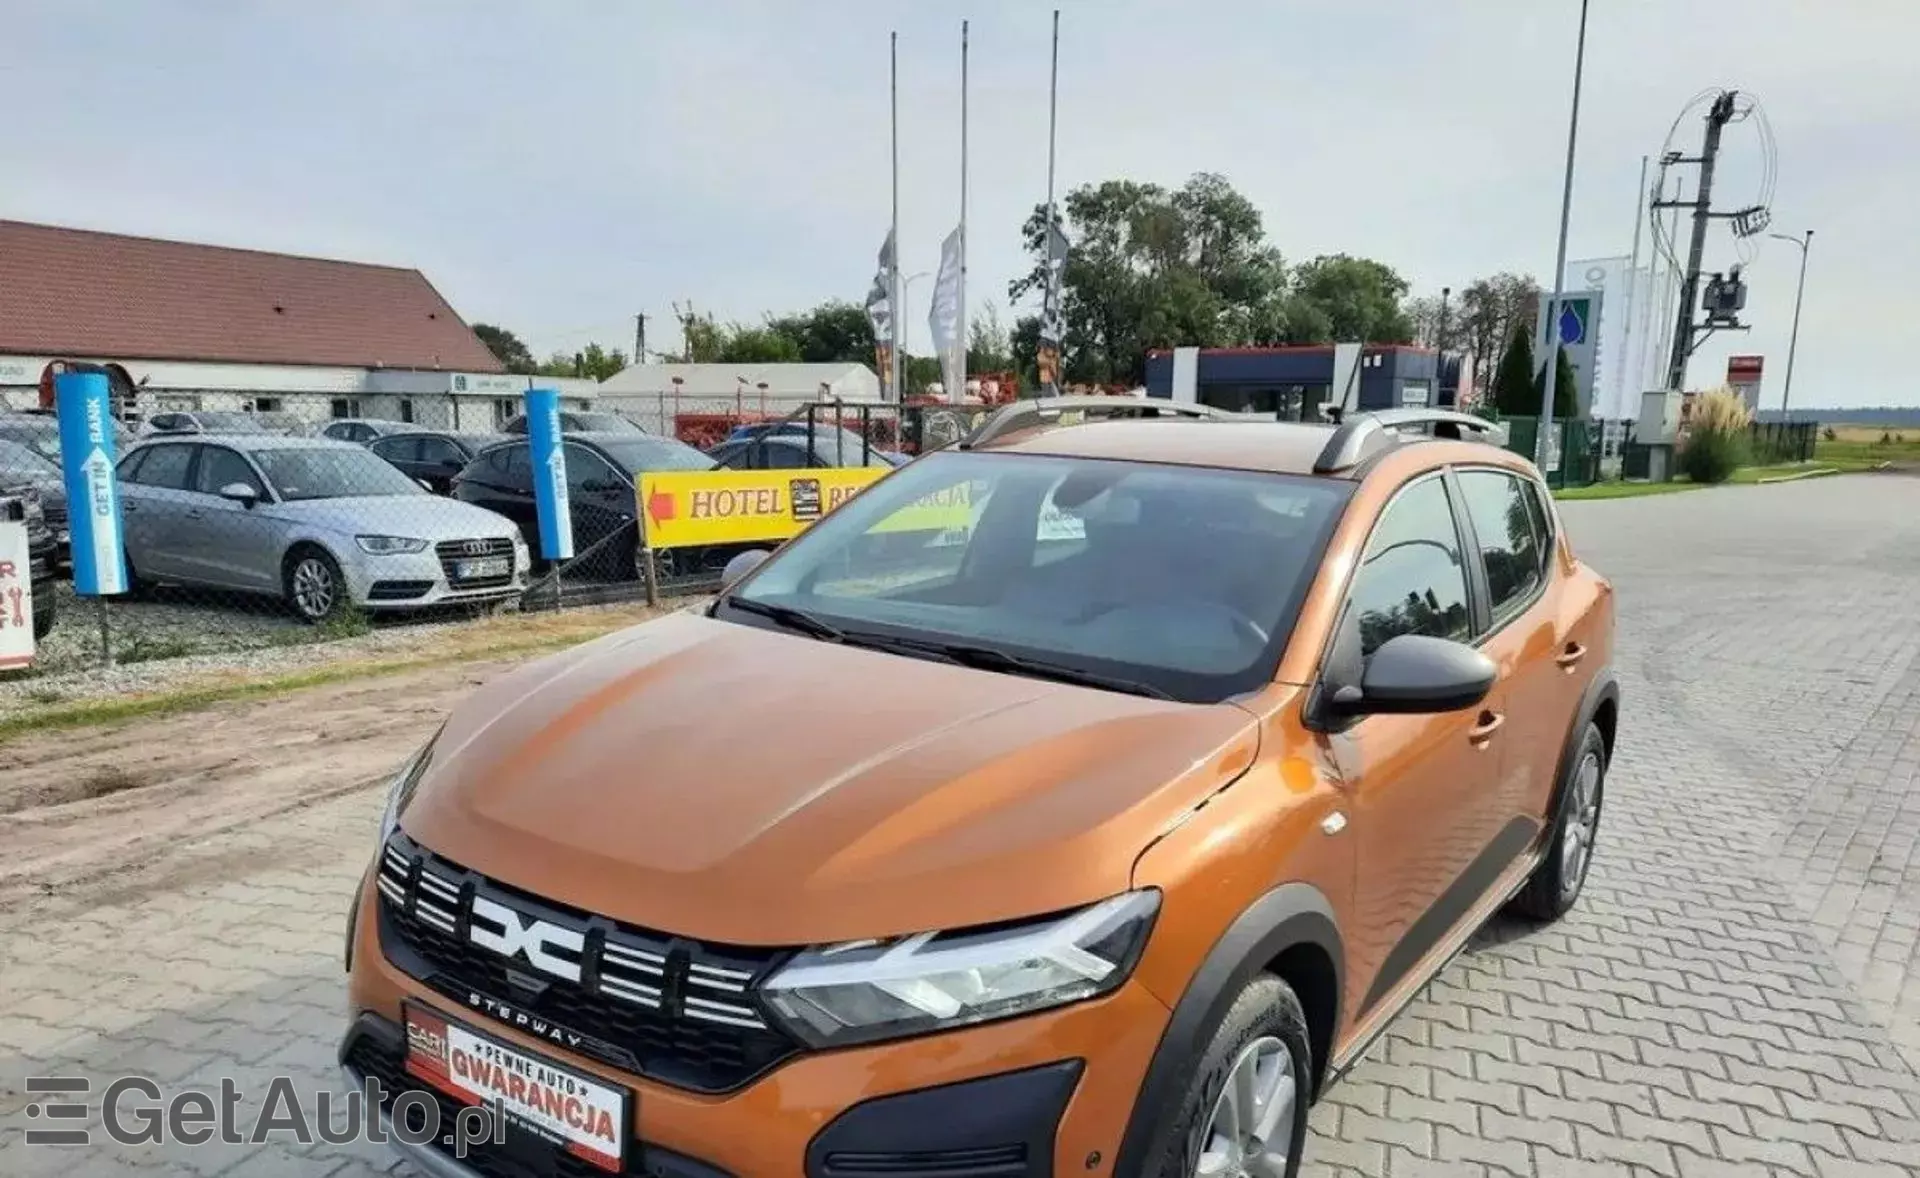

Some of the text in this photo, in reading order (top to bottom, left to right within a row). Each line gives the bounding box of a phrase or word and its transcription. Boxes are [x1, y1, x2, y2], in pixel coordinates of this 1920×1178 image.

[87, 398, 105, 444] BANK
[690, 488, 785, 518] HOTEL
[469, 993, 583, 1047] STEPWAY
[487, 1046, 576, 1094] PEWNE AUTO
[451, 1048, 616, 1144] GWARANCJA
